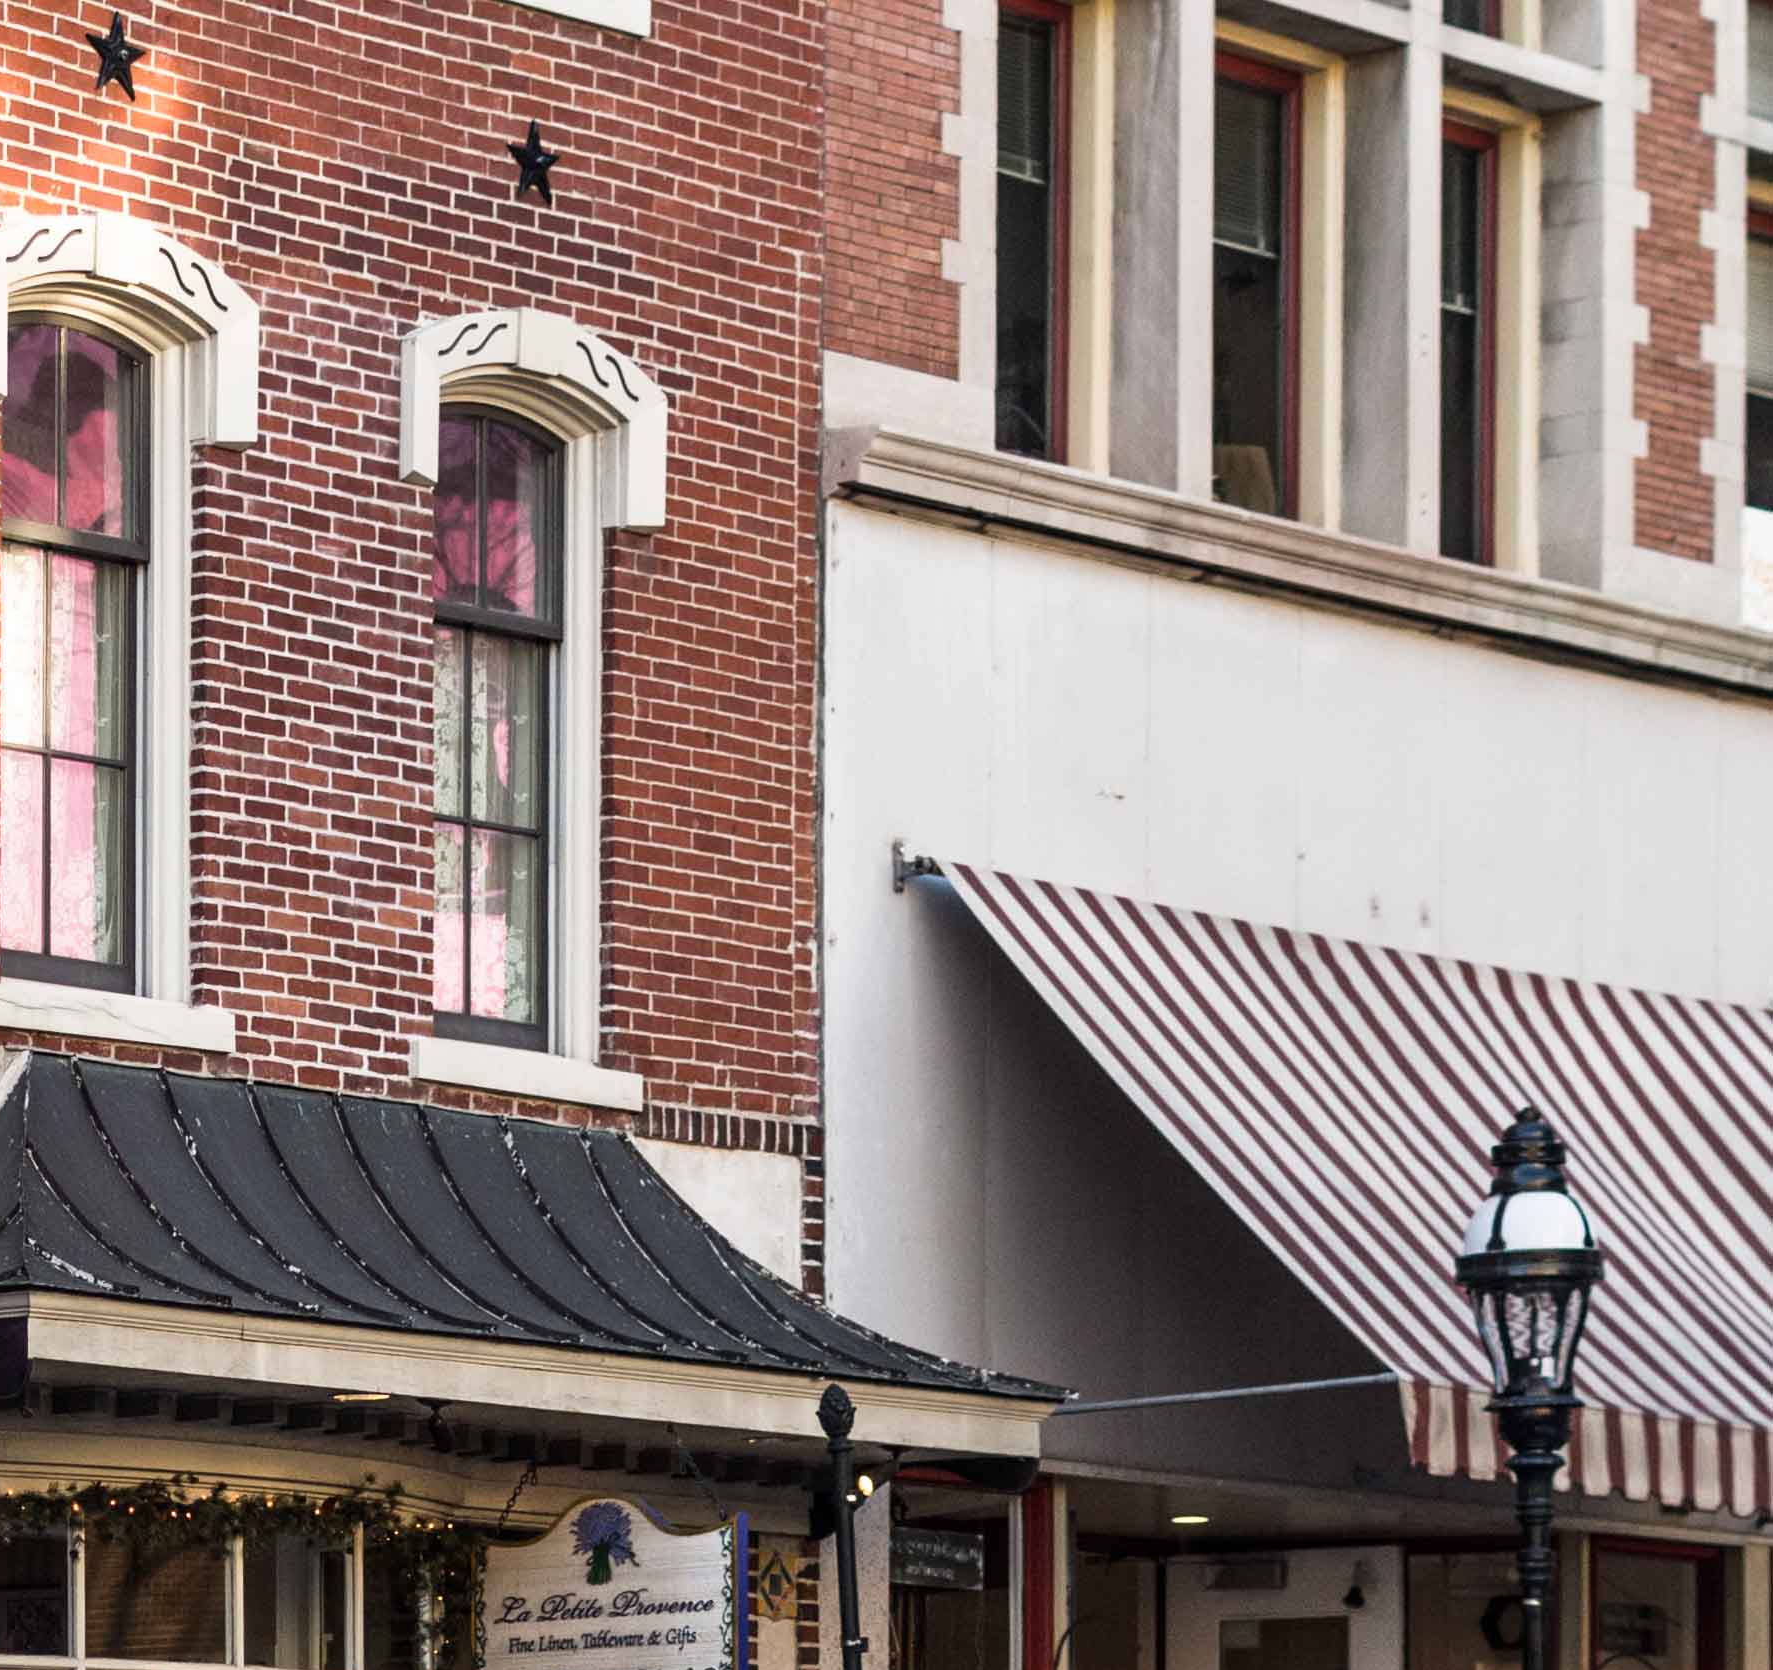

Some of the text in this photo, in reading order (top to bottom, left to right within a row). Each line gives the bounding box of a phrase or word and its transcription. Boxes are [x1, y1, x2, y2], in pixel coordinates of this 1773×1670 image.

[493, 1588, 715, 1625] La Petite Provence
[508, 1636, 535, 1654] Fine
[538, 1634, 578, 1653] Linen,
[581, 1629, 644, 1649] Tableware
[665, 1625, 697, 1651] Gifts
